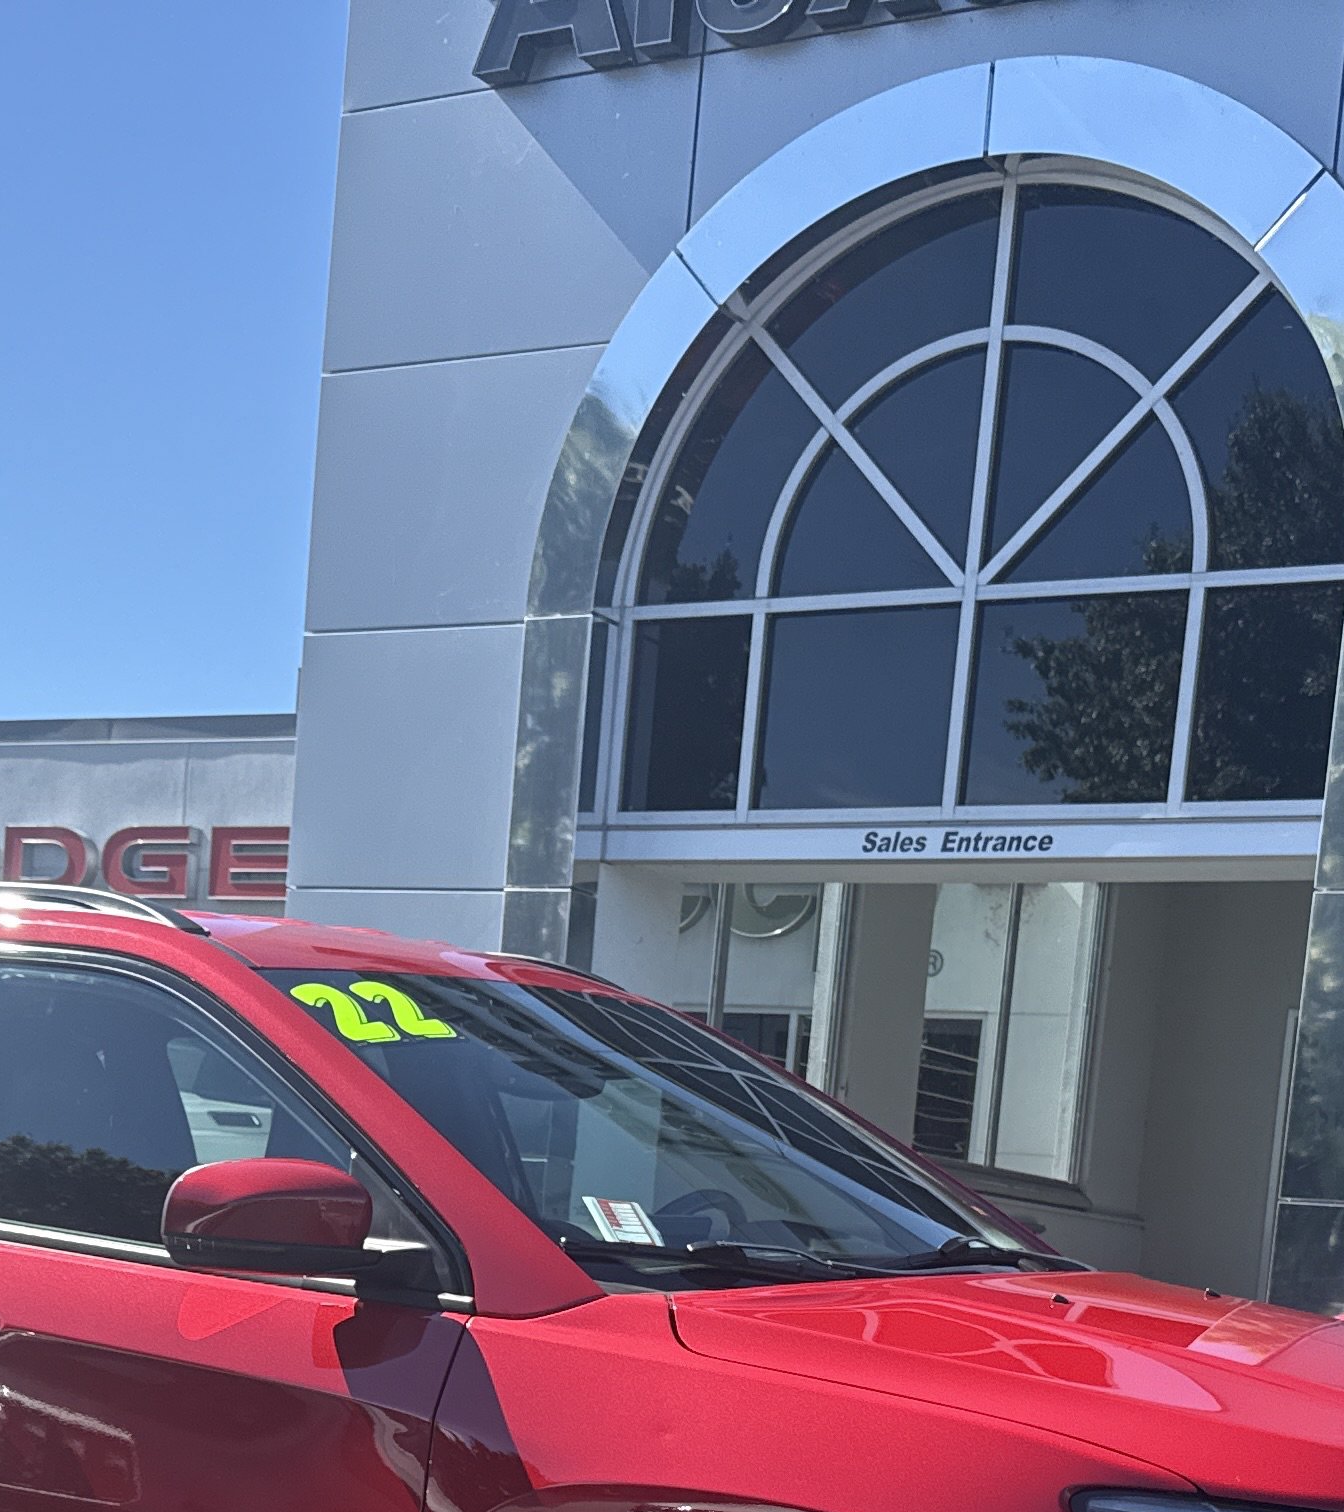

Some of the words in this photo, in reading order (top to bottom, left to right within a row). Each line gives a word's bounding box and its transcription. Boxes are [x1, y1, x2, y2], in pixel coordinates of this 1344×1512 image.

[862, 831, 928, 853] Sales
[940, 831, 1054, 853] Entrance
[289, 980, 457, 1044] 22
